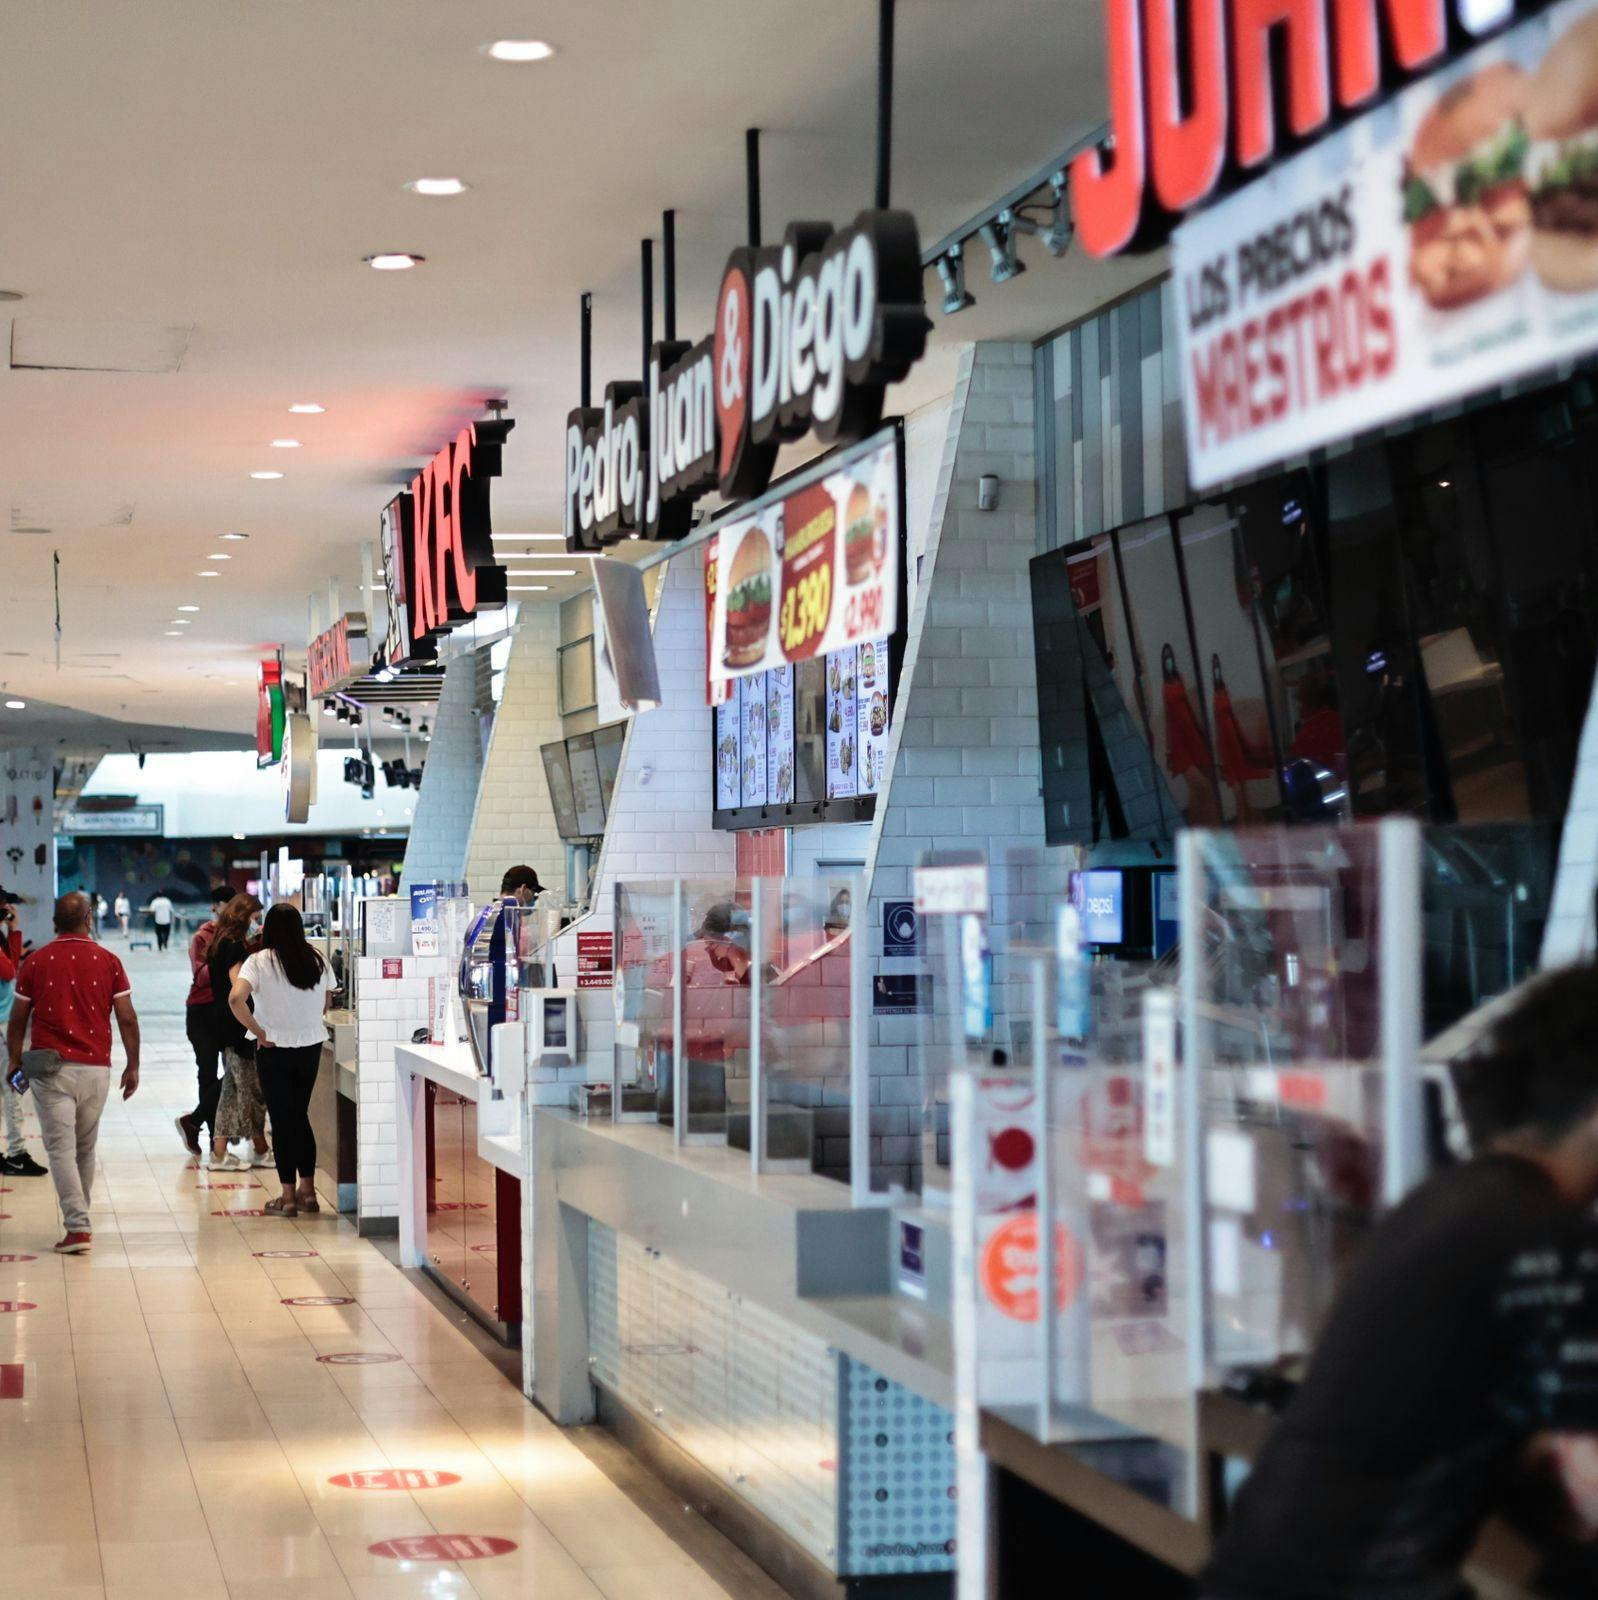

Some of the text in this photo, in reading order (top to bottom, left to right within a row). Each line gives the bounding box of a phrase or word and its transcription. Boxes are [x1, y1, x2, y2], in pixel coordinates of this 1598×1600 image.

[1186, 183, 1354, 331] LOS PRECIOS
[1189, 256, 1399, 450] MAESTROS
[566, 233, 875, 538] Pedro, Juan & Diego
[411, 428, 476, 640] KFC
